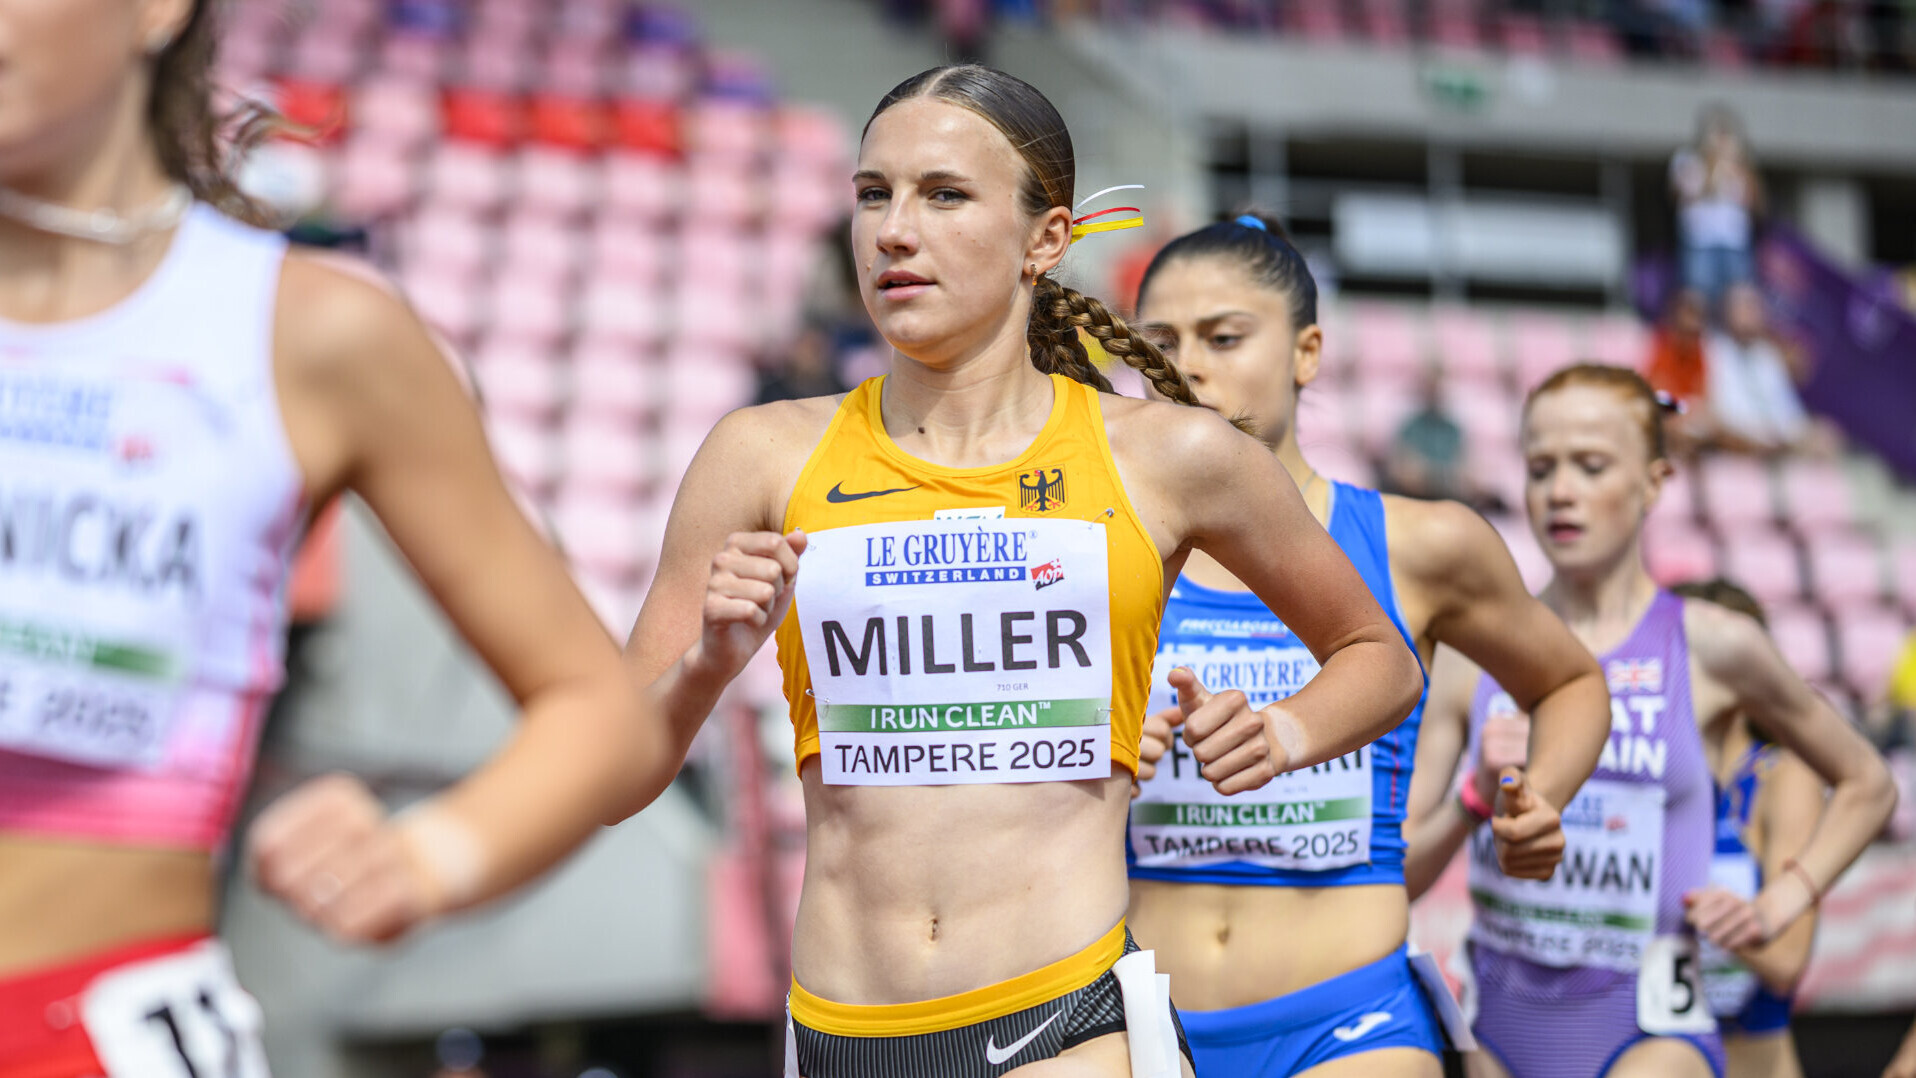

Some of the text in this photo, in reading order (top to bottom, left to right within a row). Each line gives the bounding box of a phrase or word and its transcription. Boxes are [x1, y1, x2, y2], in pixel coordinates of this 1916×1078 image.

[866, 536, 896, 567] LE
[872, 568, 1020, 584] SWITZERLAND
[821, 609, 1092, 677] MILLER
[1013, 683, 1029, 691] GER
[870, 708, 876, 729] I
[881, 707, 938, 729] RUN
[834, 738, 1096, 774] TAMPERE 2025
[1176, 806, 1184, 824] I
[1186, 804, 1233, 825] RUN
[1144, 830, 1359, 860] TAMPERE 2025
[1472, 834, 1654, 892] MWAN
[1670, 955, 1693, 1015] 5
